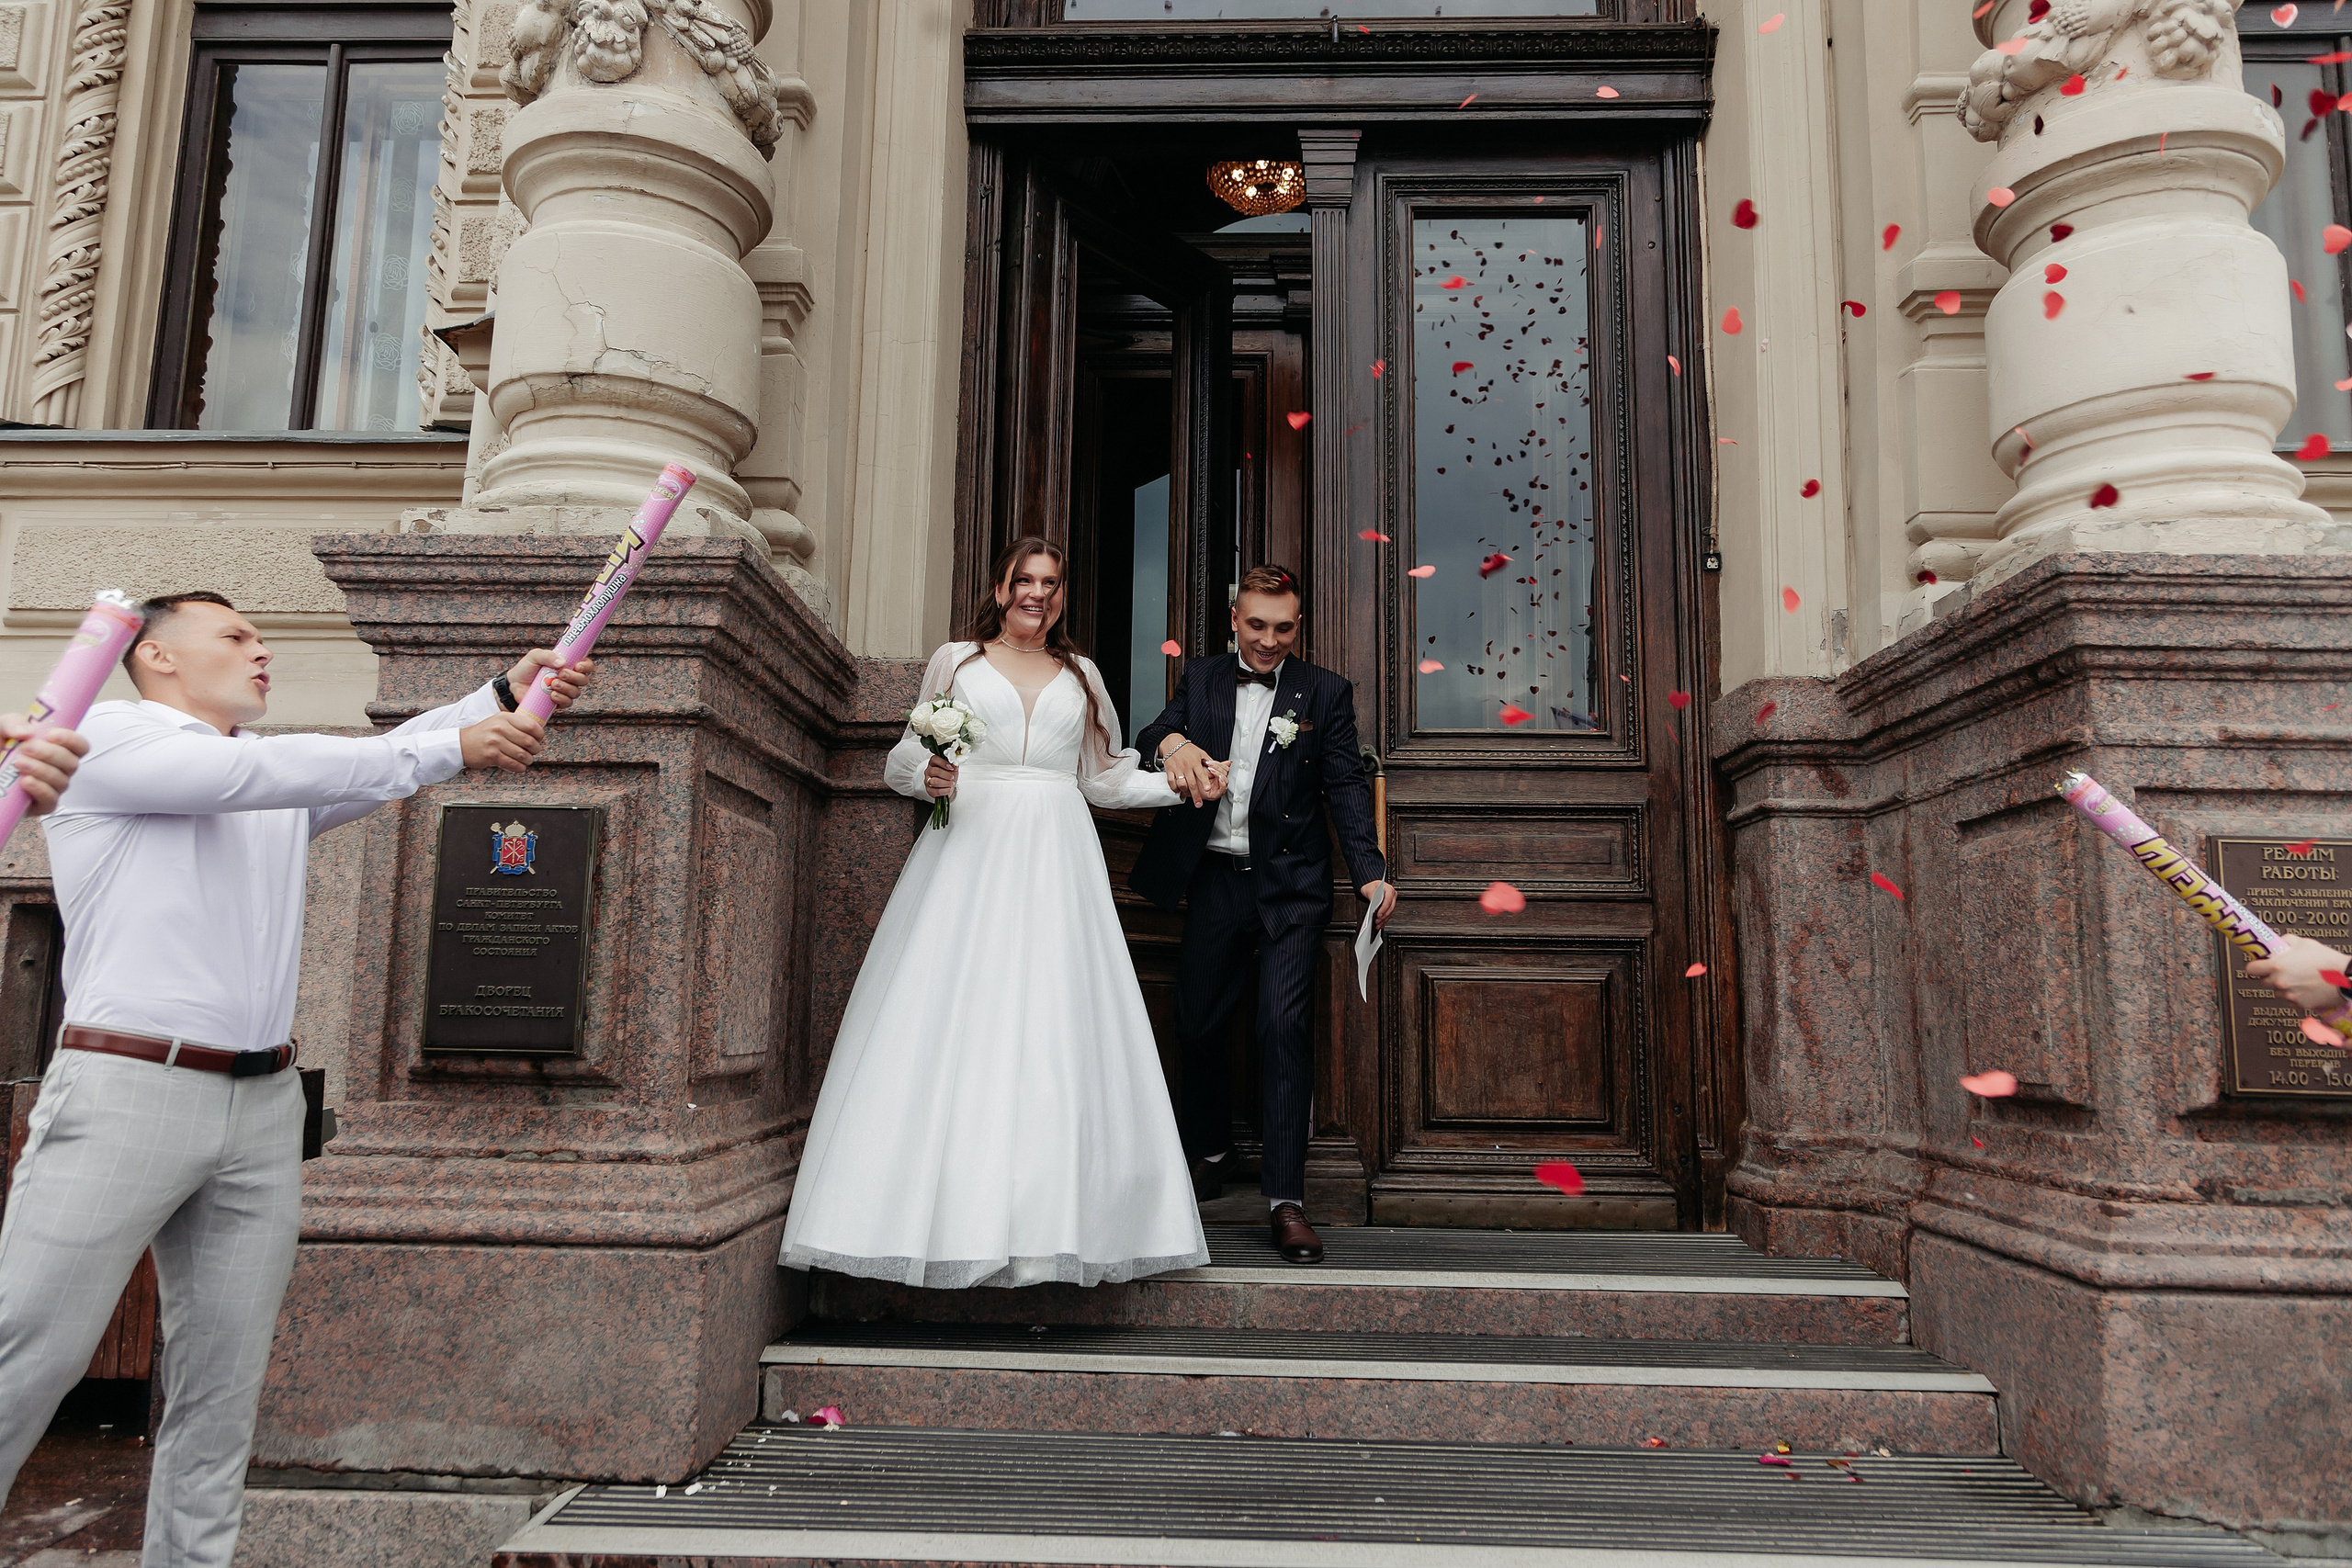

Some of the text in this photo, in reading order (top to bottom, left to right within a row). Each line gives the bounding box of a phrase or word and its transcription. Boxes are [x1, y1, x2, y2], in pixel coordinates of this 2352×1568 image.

[562, 572, 628, 648] пневмохлопушка
[2261, 865, 2339, 880] РАБОТЫ:
[465, 887, 558, 897] ПРАВИТЕЛЬСТВО
[2246, 887, 2285, 897] ПРИЕМ
[2131, 835, 2271, 961] УМФЕТИ
[2251, 898, 2328, 908] ЗАКЛЮЧЕНИИ
[456, 899, 563, 909] САНКТ-ПЕТЕРБУРГА
[484, 911, 534, 921] КОМИТЕТ
[438, 922, 579, 934] ПО ДЕЛАМ ЗАПИСИ АКТОВ
[462, 935, 550, 945] ГРАЖДАНСКОГО
[473, 947, 537, 957] СОСТОЯНИЯ
[475, 985, 532, 998] ДВОРЕЦ
[2237, 988, 2276, 998] ЧЕТВЕ
[438, 1004, 565, 1018] БРАКОСОЧЕТАНИЯ
[2253, 1007, 2299, 1017] ВЫДАЧА
[2269, 1047, 2291, 1056] БЕЗ
